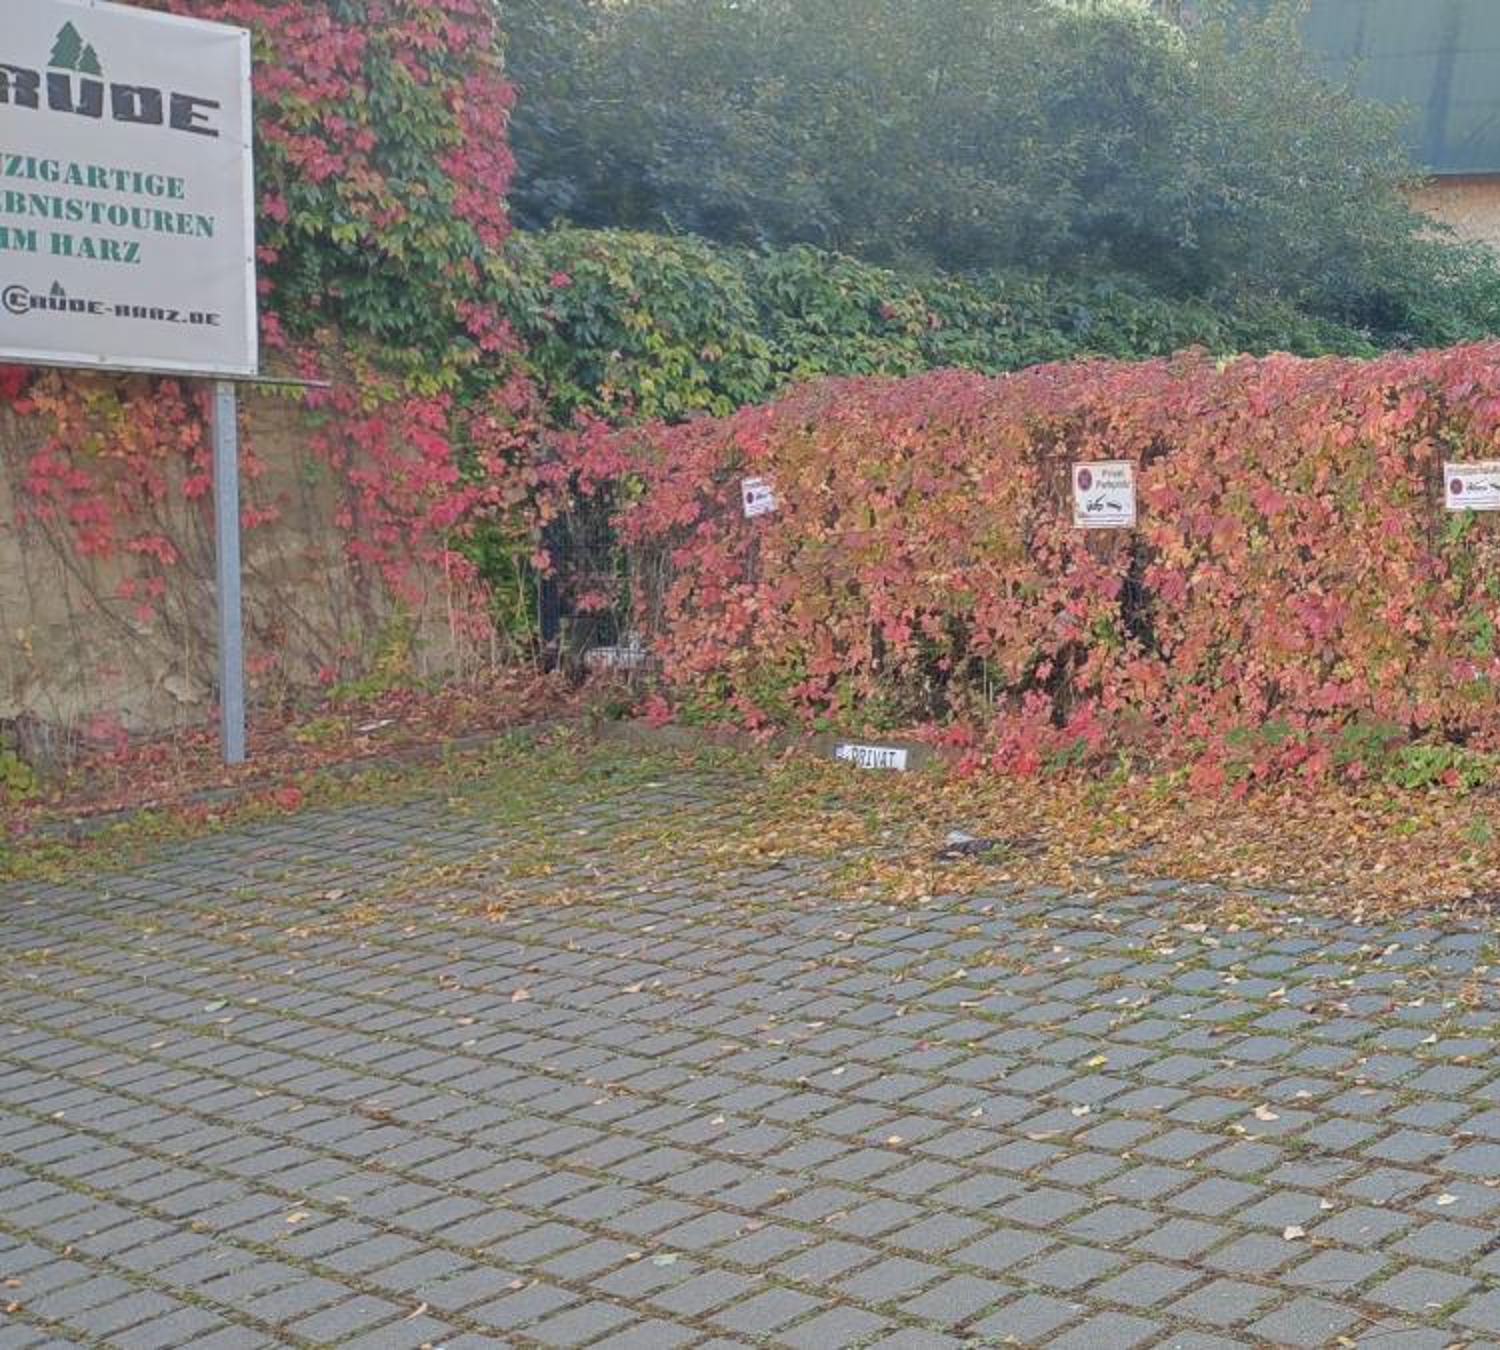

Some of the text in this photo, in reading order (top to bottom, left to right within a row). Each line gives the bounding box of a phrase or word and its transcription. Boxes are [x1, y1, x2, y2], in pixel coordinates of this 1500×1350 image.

[0, 154, 185, 199] ZIGARTIGE
[0, 190, 215, 238] BNISTOUREN
[50, 232, 141, 264] HARZ
